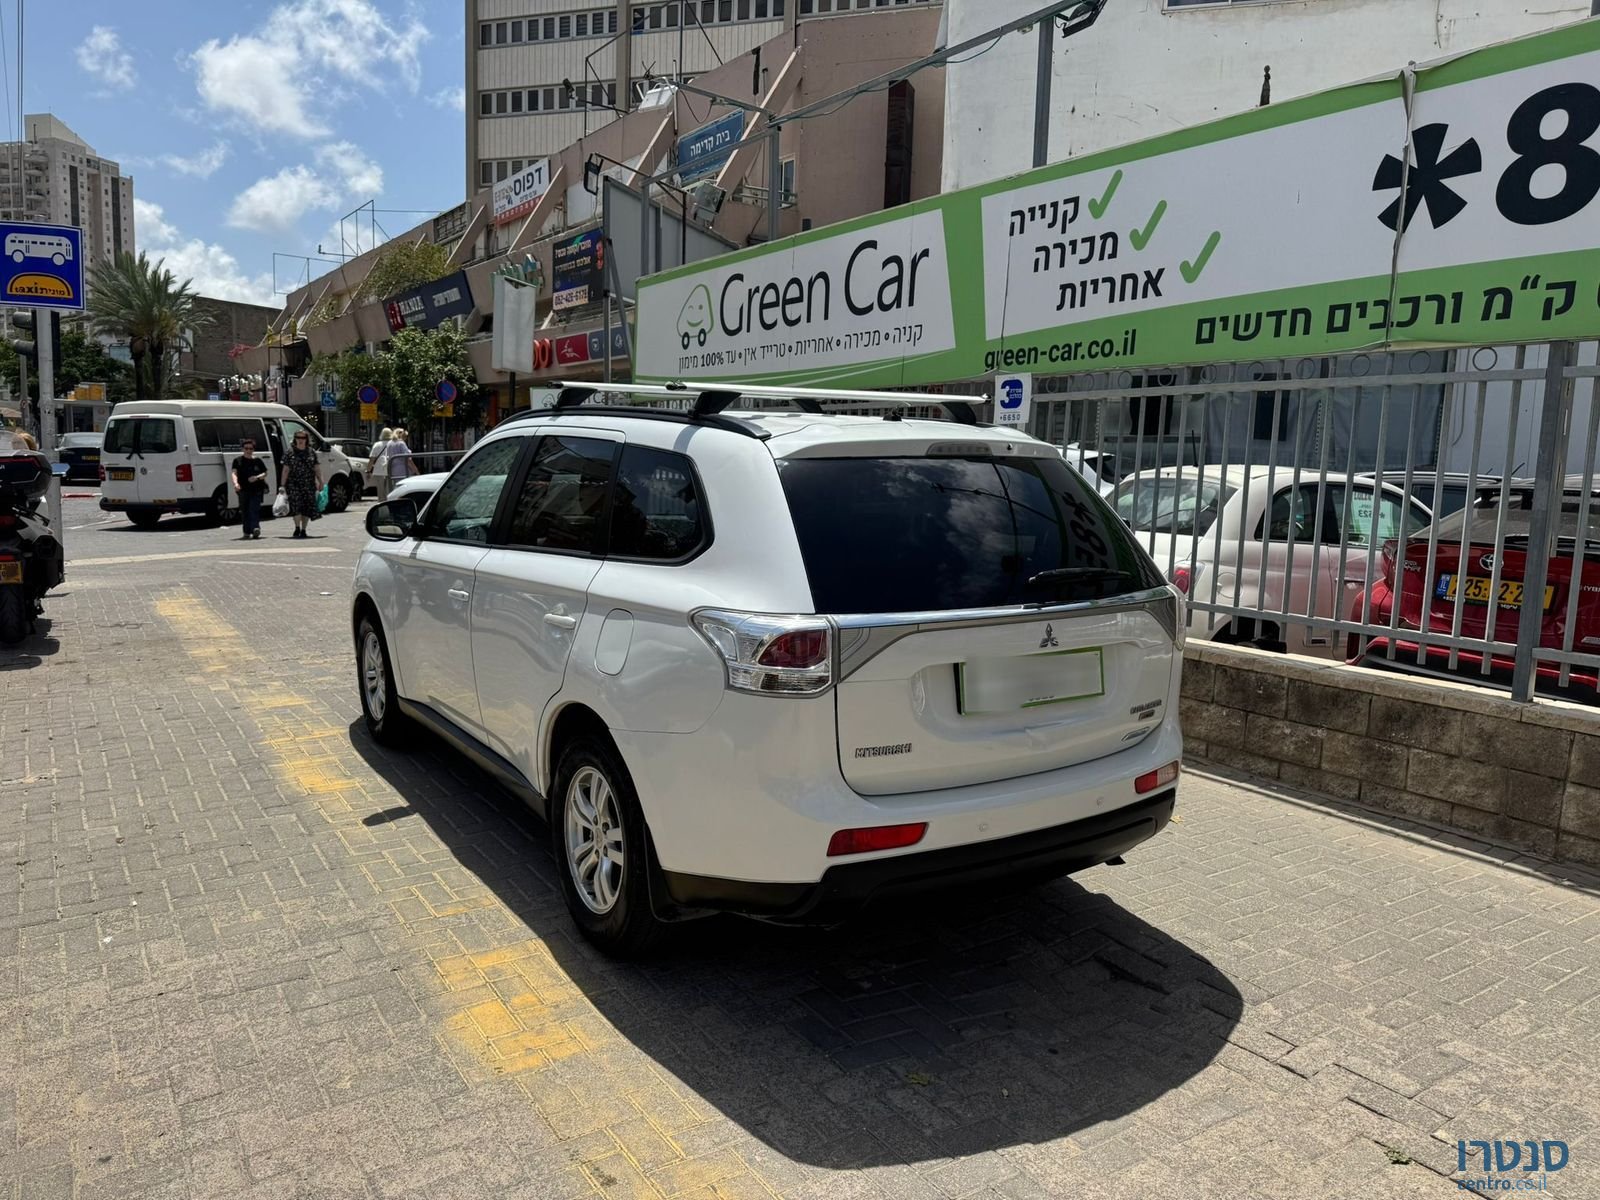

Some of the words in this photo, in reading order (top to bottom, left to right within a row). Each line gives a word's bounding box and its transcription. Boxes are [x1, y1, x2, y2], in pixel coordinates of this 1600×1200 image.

[690, 136, 714, 157] קדימה
[716, 130, 730, 146] בית
[513, 166, 543, 196] דפוס
[1009, 196, 1080, 237] קנייה
[1033, 231, 1119, 273] מכירה
[15, 282, 38, 294] taxi
[39, 287, 65, 296] מונית
[719, 271, 831, 337] Green
[844, 239, 930, 316] Car
[1056, 267, 1166, 312] אחריות
[1326, 291, 1464, 334] ורכבים
[892, 324, 923, 347] קניה
[1195, 307, 1313, 345] חדשים
[760, 341, 786, 359] טרייד
[794, 335, 834, 356] אחריות
[844, 329, 881, 350] מכירה
[701, 351, 724, 368] 100%
[726, 350, 736, 364] עד
[743, 347, 757, 366] אין
[984, 329, 1137, 372] green-car.co.il
[678, 354, 698, 374] מימון
[855, 742, 912, 758] MITSUBISHI
